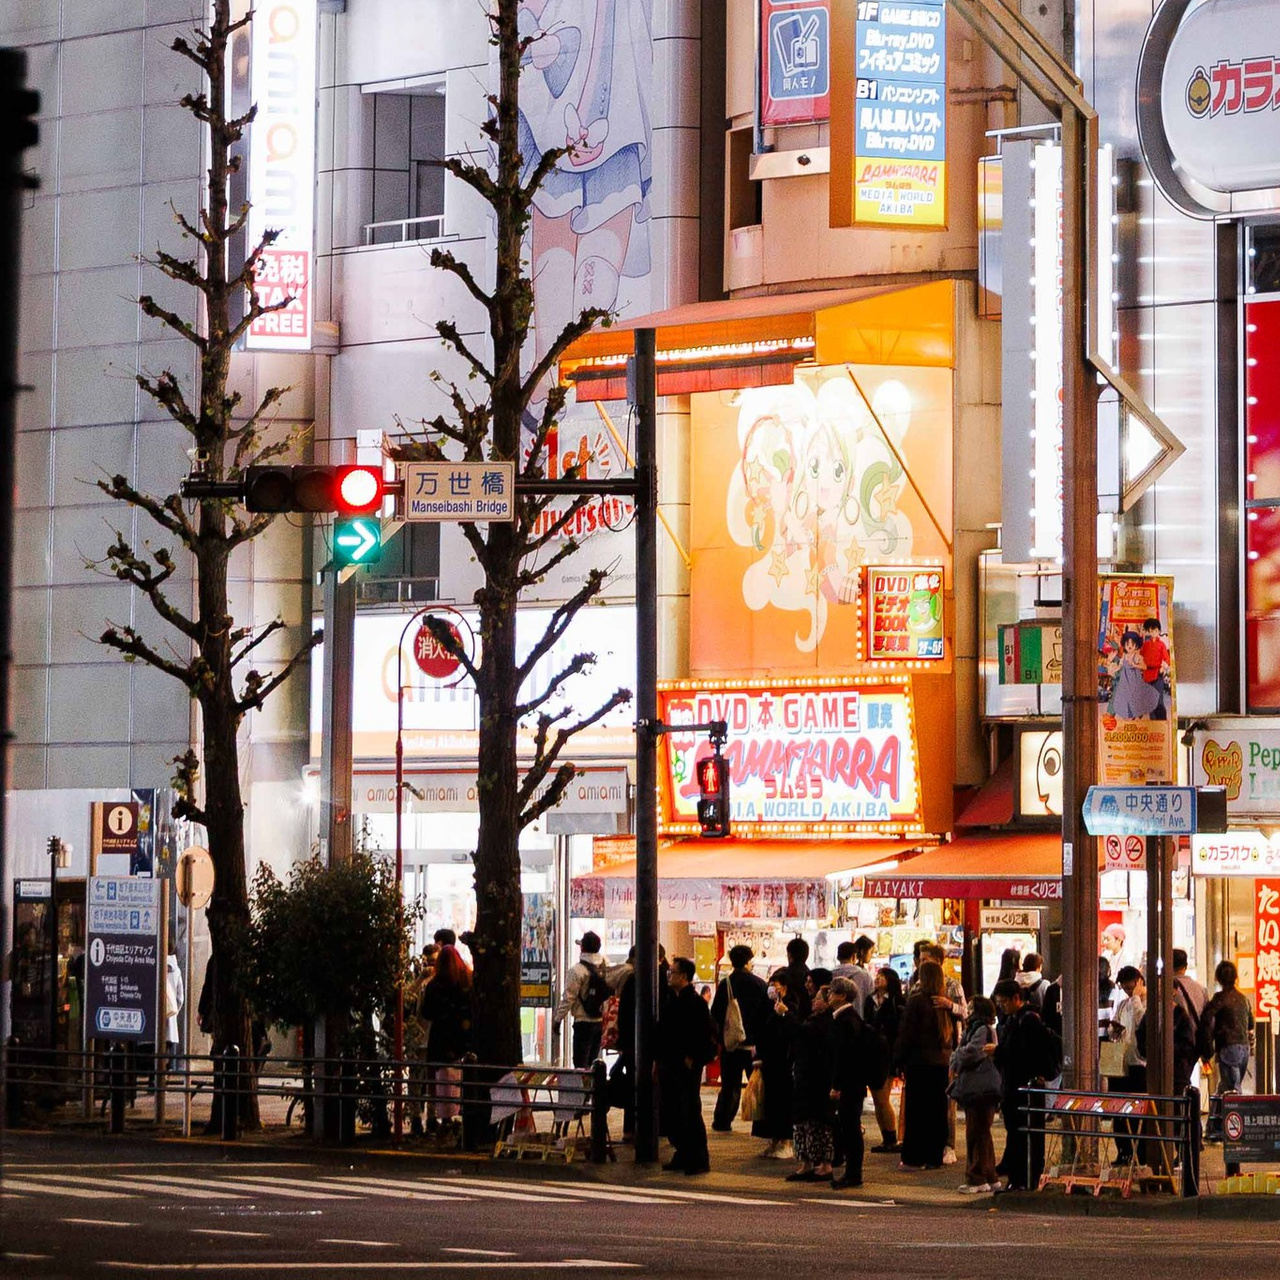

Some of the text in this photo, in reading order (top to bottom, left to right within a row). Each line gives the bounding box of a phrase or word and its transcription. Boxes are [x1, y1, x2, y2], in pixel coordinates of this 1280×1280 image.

[857, 1, 879, 21] 1F
[856, 79, 878, 100] B1
[859, 189, 934, 203] MEDIA WORLD
[879, 203, 914, 216] AKIBA
[256, 285, 304, 311] TAX
[253, 313, 305, 335] FREE
[416, 471, 505, 496] 万世橋
[411, 500, 508, 515] Manseibashi Bridge
[875, 576, 909, 593] DVD
[874, 614, 910, 633] BOOK
[1025, 669, 1038, 681] B1
[783, 695, 858, 729] GAME
[577, 784, 622, 802] amiami
[764, 800, 889, 818] WORLD AKIBA
[1125, 792, 1183, 813] 中央通り
[1168, 815, 1186, 827] Ave.
[1207, 844, 1251, 862] カラオケ
[867, 880, 924, 898] TAIYAKI
